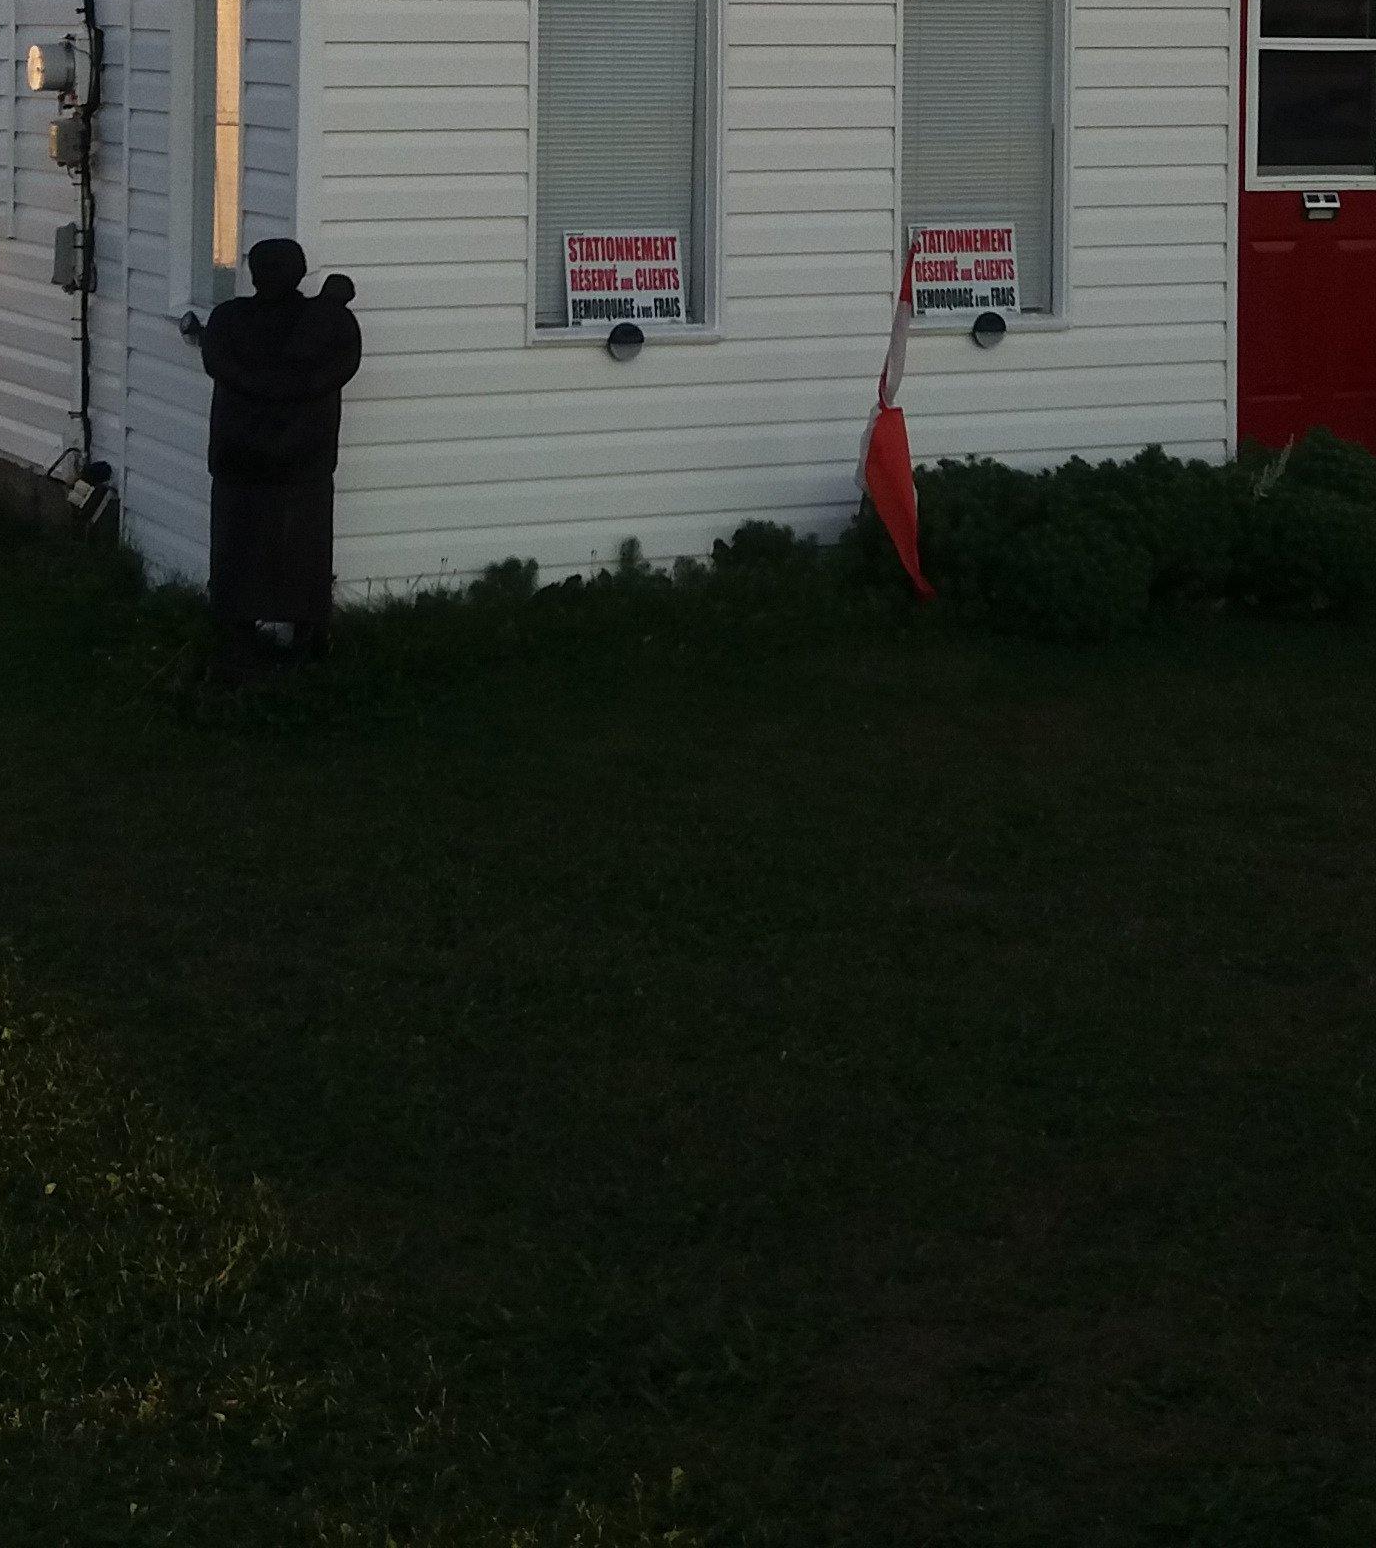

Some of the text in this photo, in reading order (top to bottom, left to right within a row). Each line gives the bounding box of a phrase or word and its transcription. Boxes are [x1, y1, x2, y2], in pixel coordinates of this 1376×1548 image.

[568, 236, 677, 262] STATIONNEMENT
[570, 264, 618, 291] RÉSERVÉ
[635, 267, 680, 291] CLIENTS
[915, 256, 959, 282] RÉSERVÉ
[974, 258, 1015, 280] CLIENTS
[571, 297, 636, 321] REMORQUAGE
[653, 297, 681, 318] FRAIS
[916, 287, 974, 310] REMORQUAGE
[990, 286, 1015, 307] FRAIS
